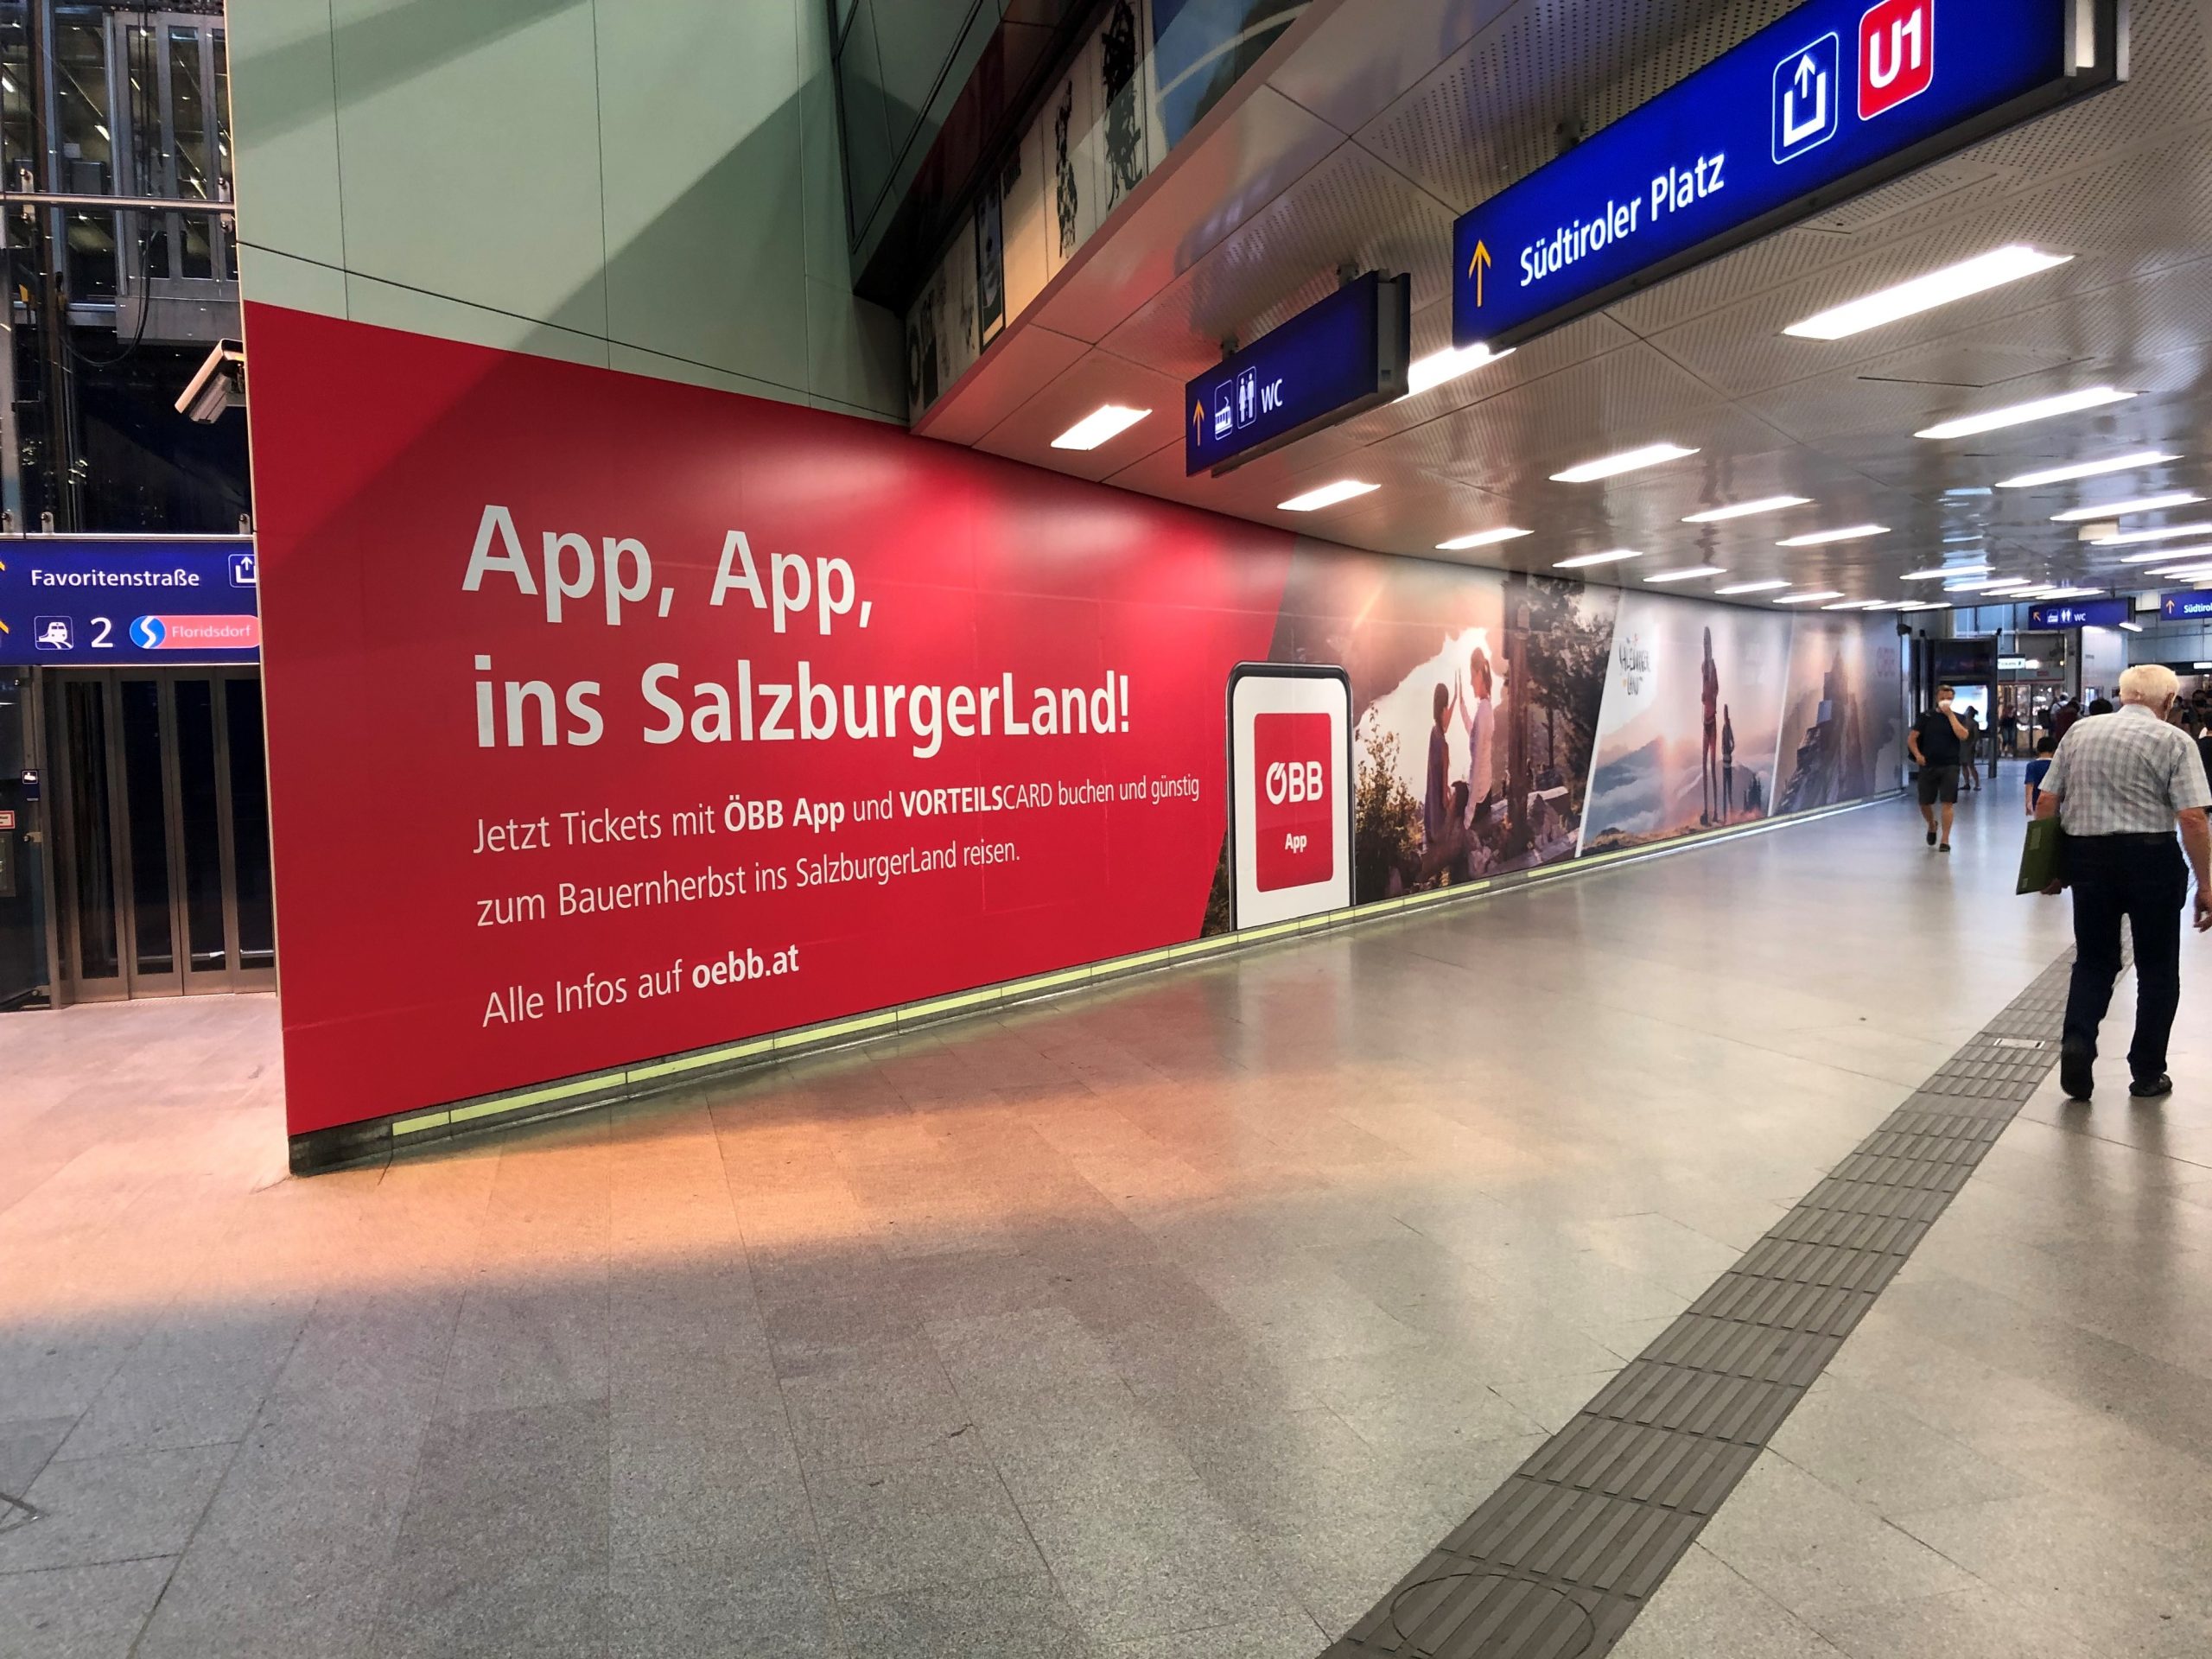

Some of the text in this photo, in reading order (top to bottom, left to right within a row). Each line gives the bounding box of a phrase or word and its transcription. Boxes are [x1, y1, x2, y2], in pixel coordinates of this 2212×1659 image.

[1869, 7, 1922, 89] U1
[1520, 152, 1725, 288] Südtiroler Platz
[1261, 378, 1283, 414] WC
[31, 569, 200, 587] Favoritenstraße
[461, 505, 873, 636] App, App,
[91, 617, 113, 648] 2
[172, 626, 251, 639] Floridsdorf
[2074, 613, 2087, 622] WC
[474, 654, 1129, 759] ins SalzburgerLand!
[473, 775, 1199, 854] Jetzt Tickets mit ÖBB App und VORTEILSCARD buchen und günstig
[1265, 760, 1324, 805] ÖBB
[477, 838, 1020, 926] zum Bauernherbst ins SalzburgerLand reisen.
[1284, 833, 1307, 854] App
[482, 944, 799, 1027] Alle Infos auf oebb.at
